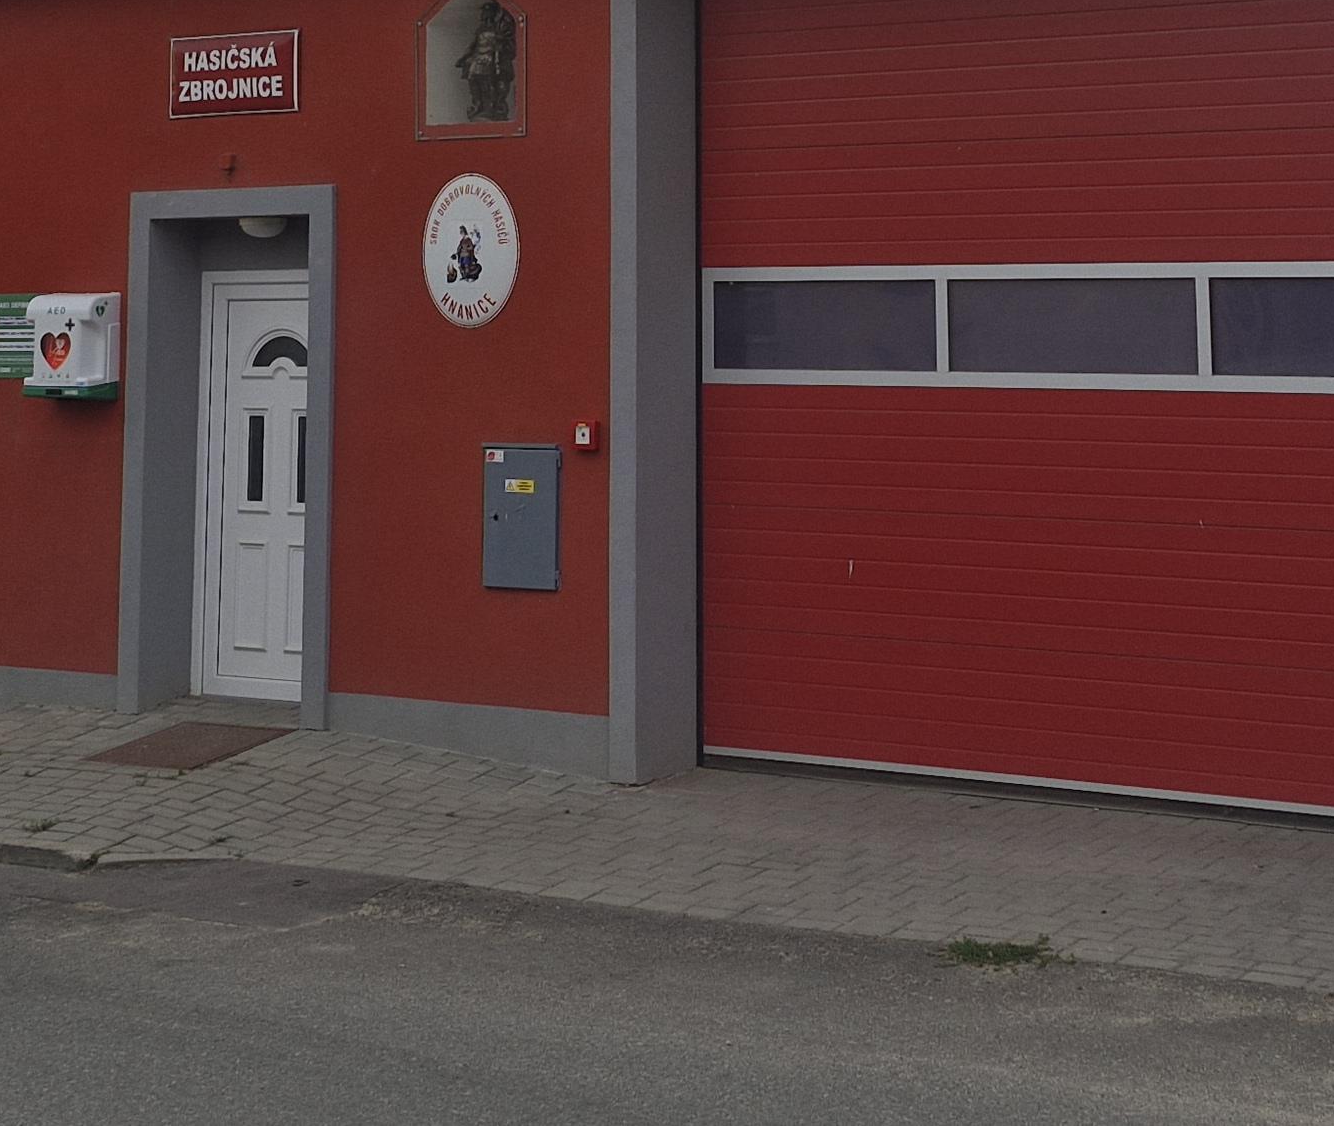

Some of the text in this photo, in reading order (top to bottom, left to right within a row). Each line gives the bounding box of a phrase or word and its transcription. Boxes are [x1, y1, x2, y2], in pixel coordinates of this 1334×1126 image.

[184, 41, 277, 72] HASIČSKÁ
[179, 75, 283, 103] ZBROJNICE
[437, 184, 496, 216] DOBROVOLNÝCH
[47, 306, 66, 315] AED
[440, 292, 496, 320] HNANICE
